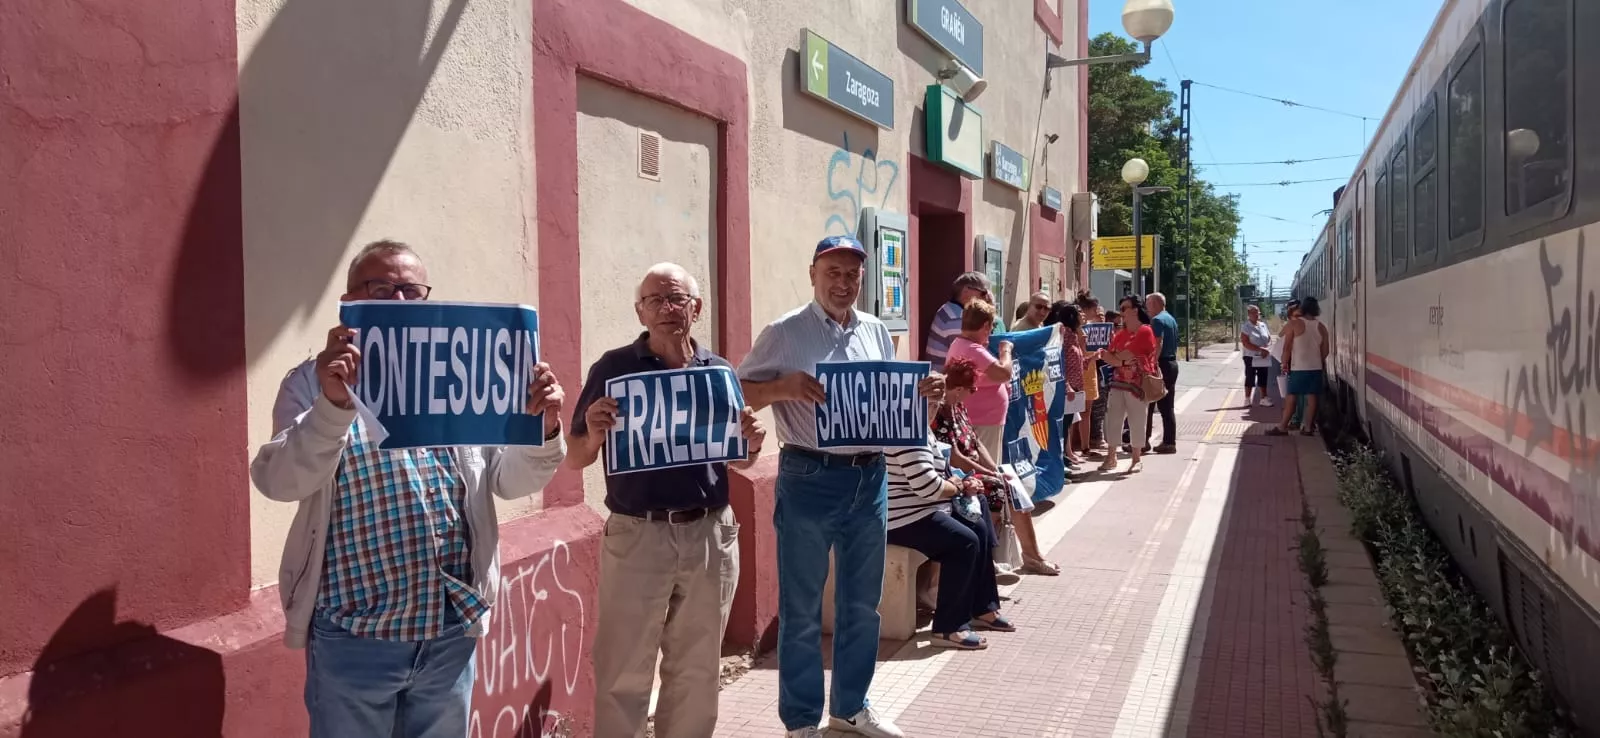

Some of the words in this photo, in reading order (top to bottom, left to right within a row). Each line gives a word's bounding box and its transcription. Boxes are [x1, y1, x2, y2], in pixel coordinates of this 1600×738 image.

[941, 5, 965, 46] GRAÑÉN
[846, 70, 880, 108] Zaragoza
[611, 372, 744, 472] FRAELLA
[816, 371, 925, 442] SANGARREN
